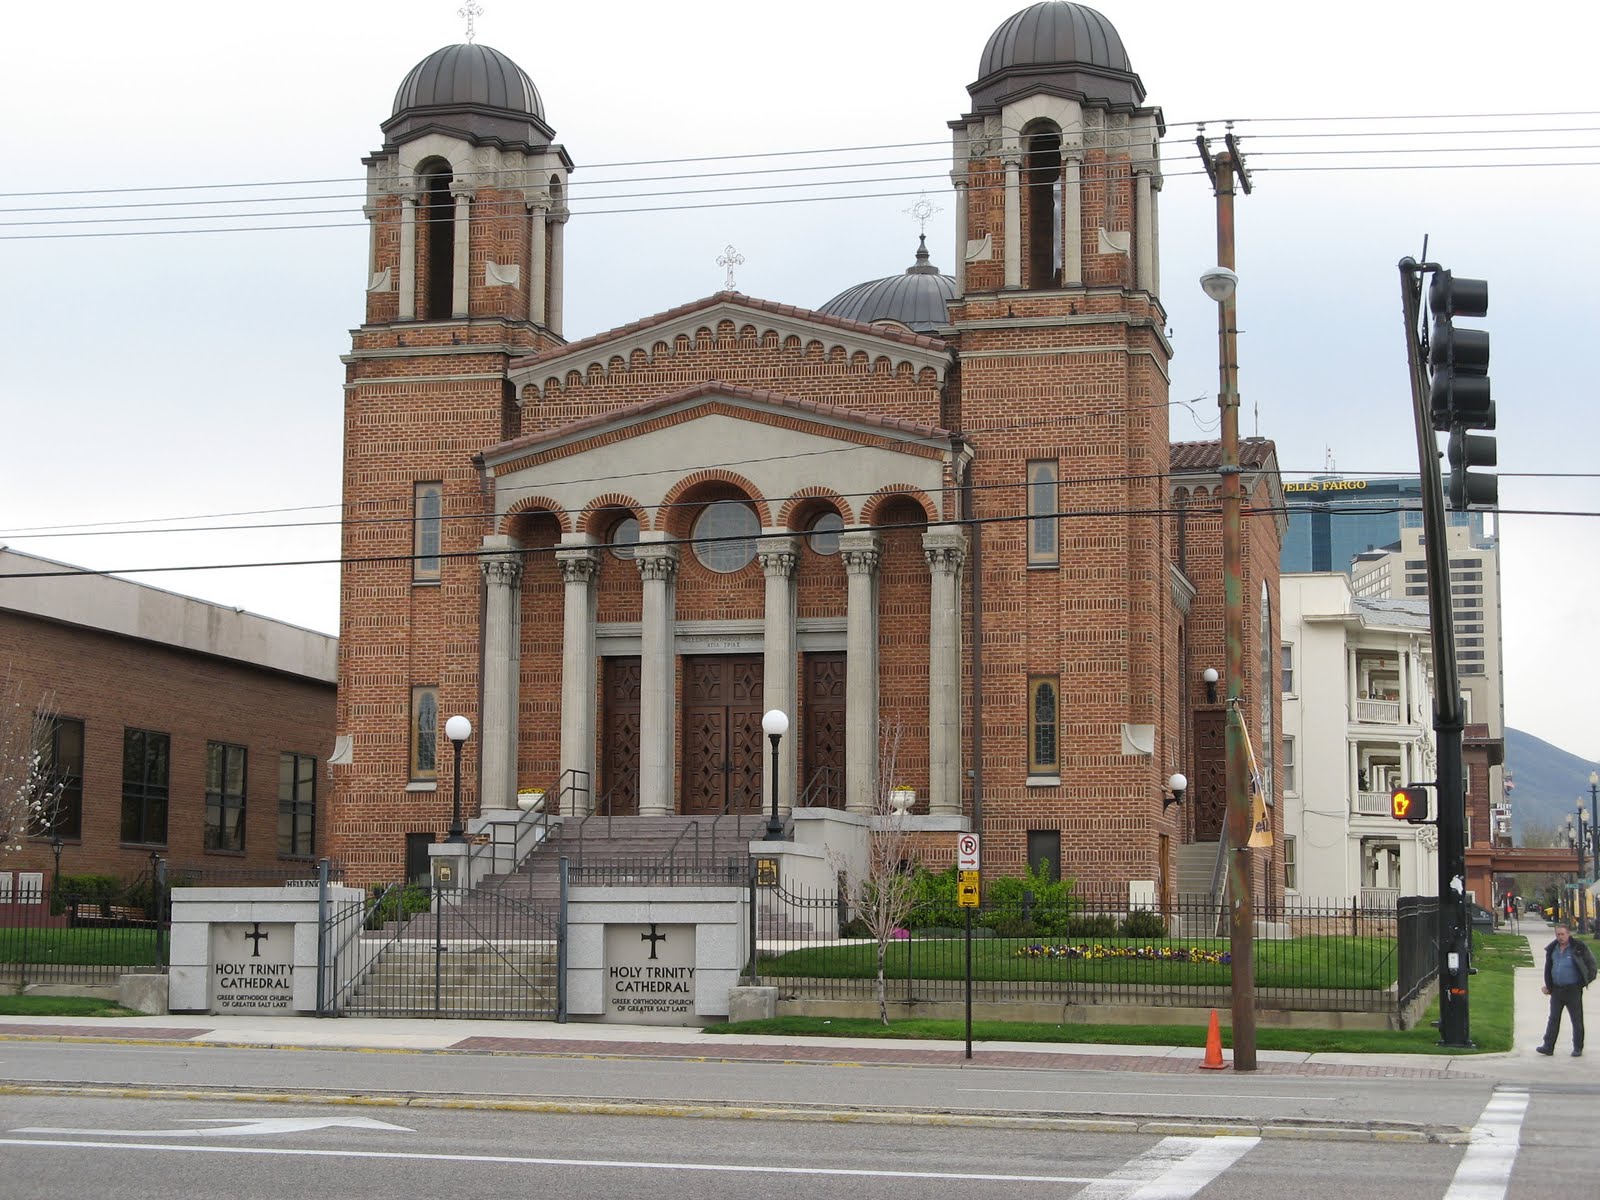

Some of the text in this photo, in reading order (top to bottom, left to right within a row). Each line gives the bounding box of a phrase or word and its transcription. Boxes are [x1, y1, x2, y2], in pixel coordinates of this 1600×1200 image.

[1322, 481, 1366, 490] FARGO
[215, 963, 295, 975] HOLY TRINITY
[609, 966, 695, 978] HOLY TRINITY
[220, 977, 290, 989] CATHEDRAL
[615, 981, 690, 993] CATHEDRAL
